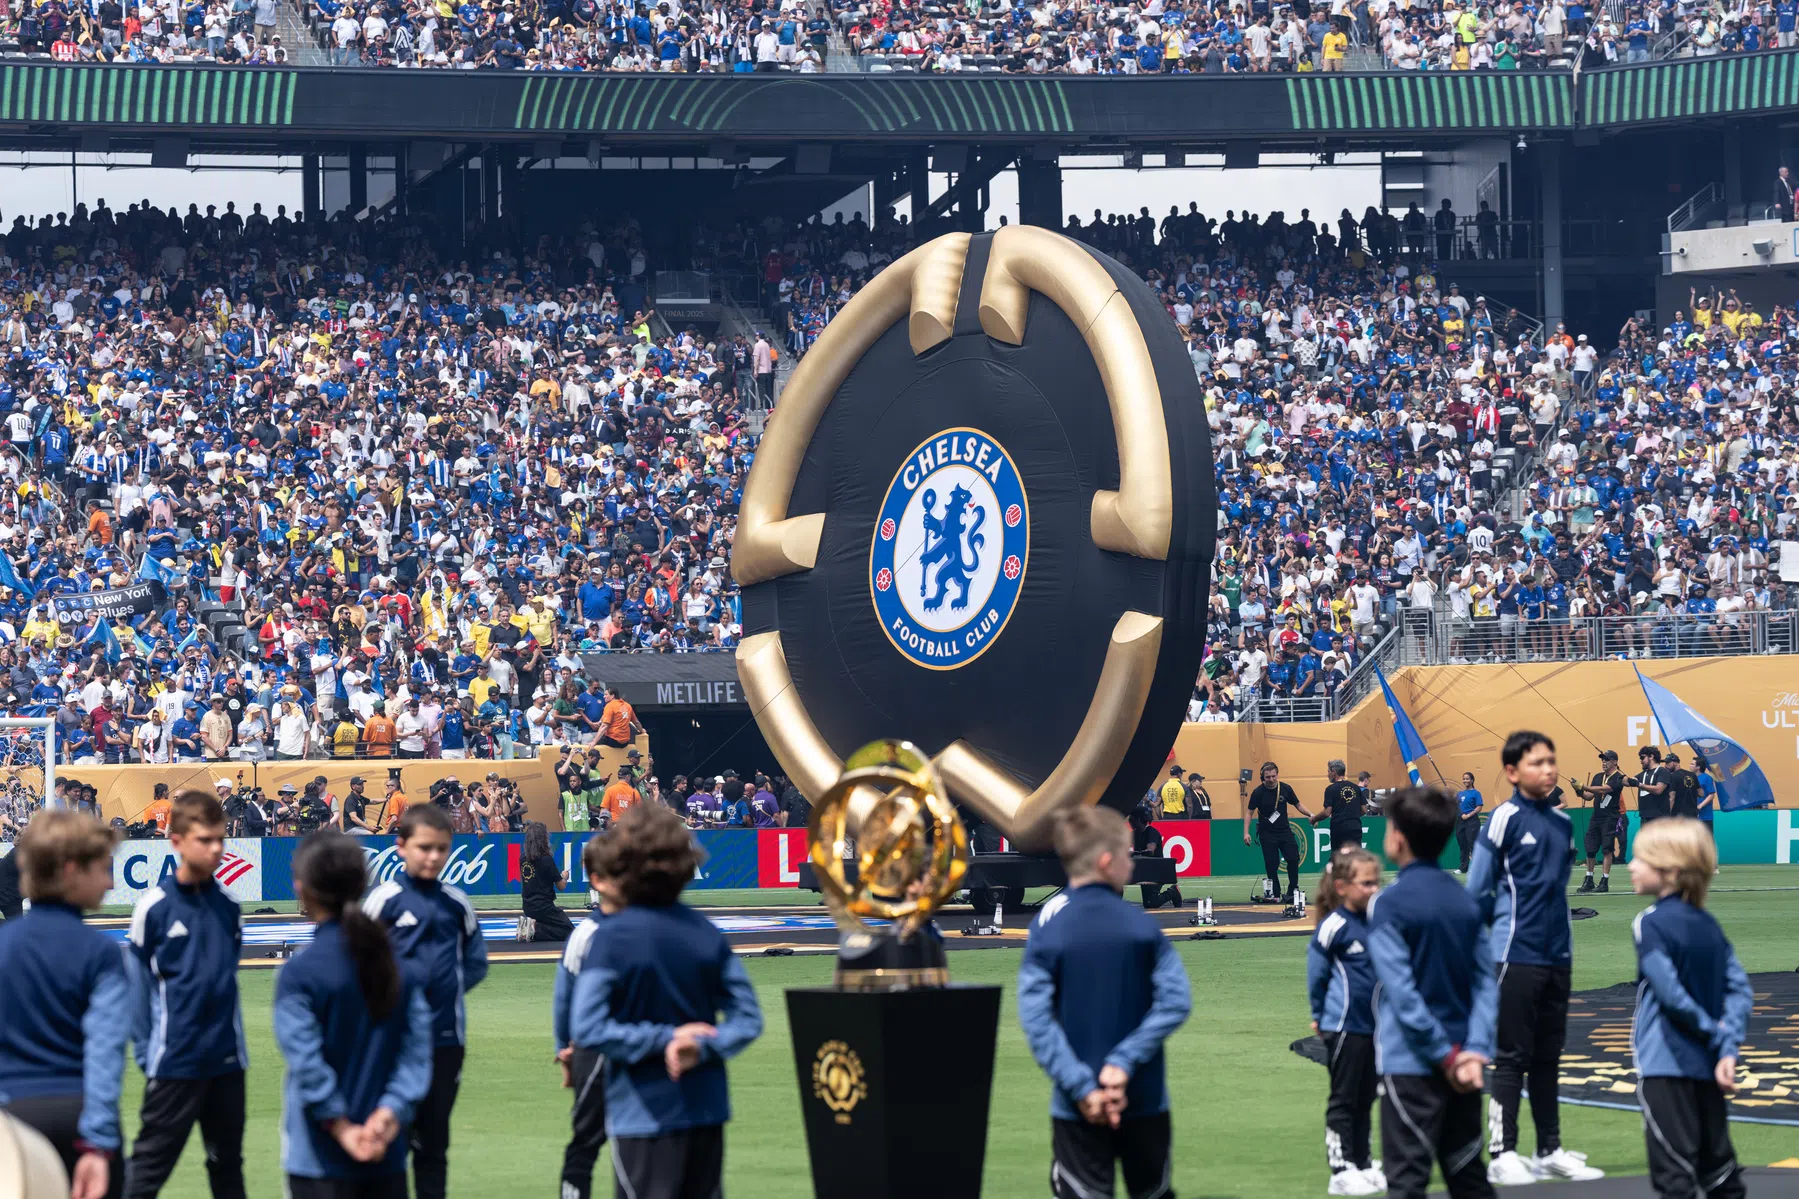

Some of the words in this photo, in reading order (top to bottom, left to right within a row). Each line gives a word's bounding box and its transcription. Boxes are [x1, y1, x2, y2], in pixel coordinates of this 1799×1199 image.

[686, 310, 705, 318] 2025
[16, 417, 27, 430] 10
[52, 436, 61, 450] 11
[903, 436, 1004, 490] CHELSEA
[1475, 535, 1487, 548] 10
[94, 594, 122, 606] New
[124, 585, 152, 601] York
[99, 604, 135, 618] Blues
[892, 617, 960, 657] FOOTBALL
[965, 608, 1000, 647] CLUB
[656, 682, 737, 704] METLIFE
